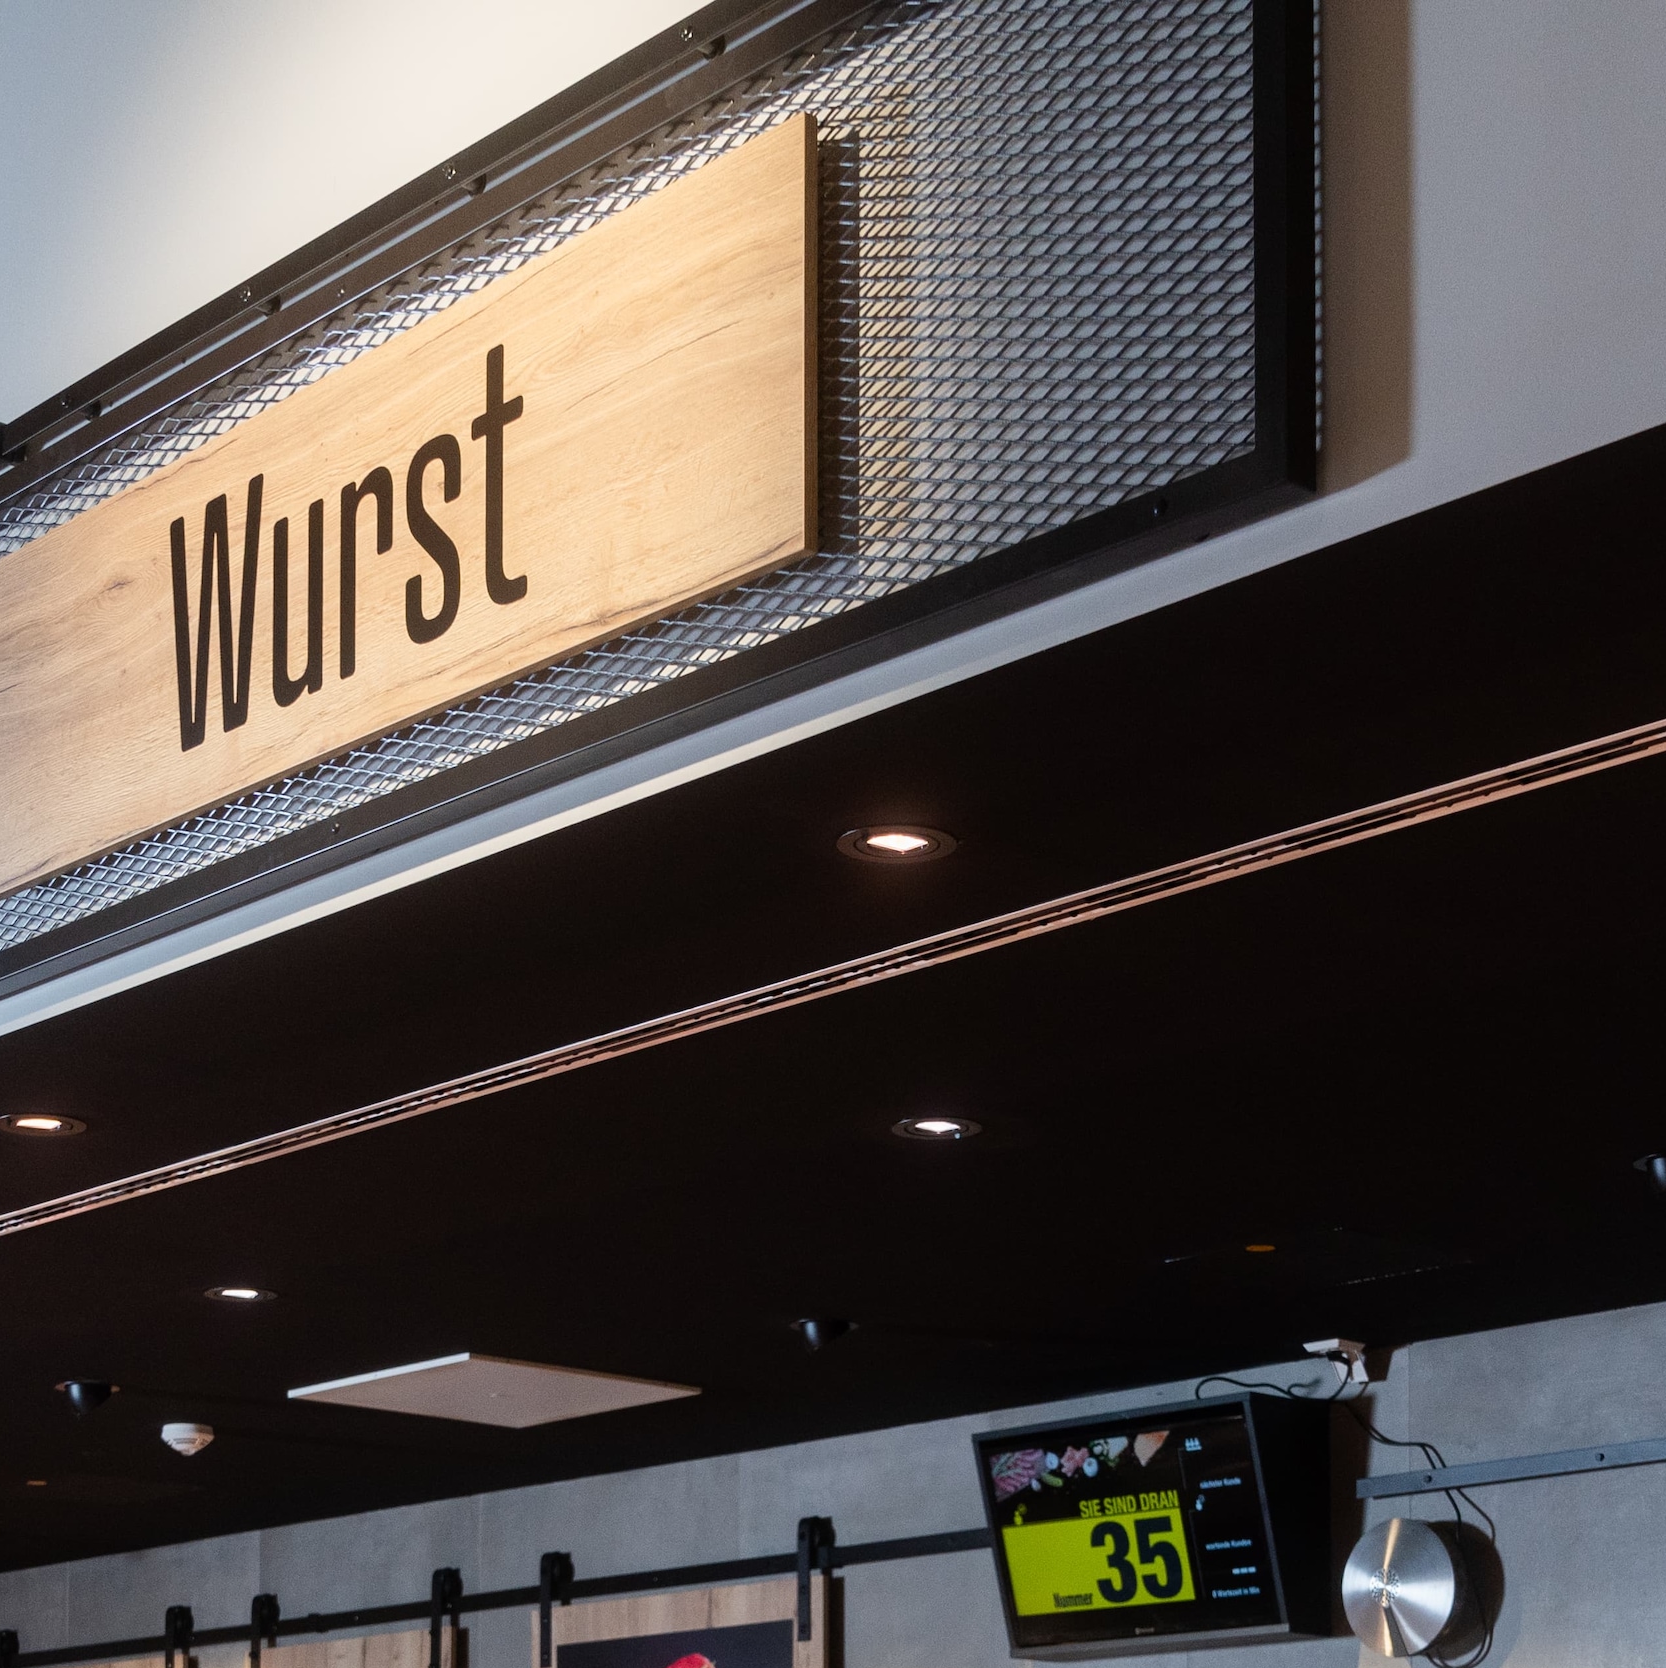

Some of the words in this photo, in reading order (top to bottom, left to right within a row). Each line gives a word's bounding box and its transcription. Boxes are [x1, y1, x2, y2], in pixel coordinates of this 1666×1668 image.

[170, 344, 528, 752] Wurst
[1079, 1498, 1102, 1518] SIE
[1104, 1494, 1138, 1516] SIND
[1140, 1490, 1179, 1511] DRAN
[1090, 1516, 1183, 1603] 35
[1052, 1591, 1094, 1609] Nummer
